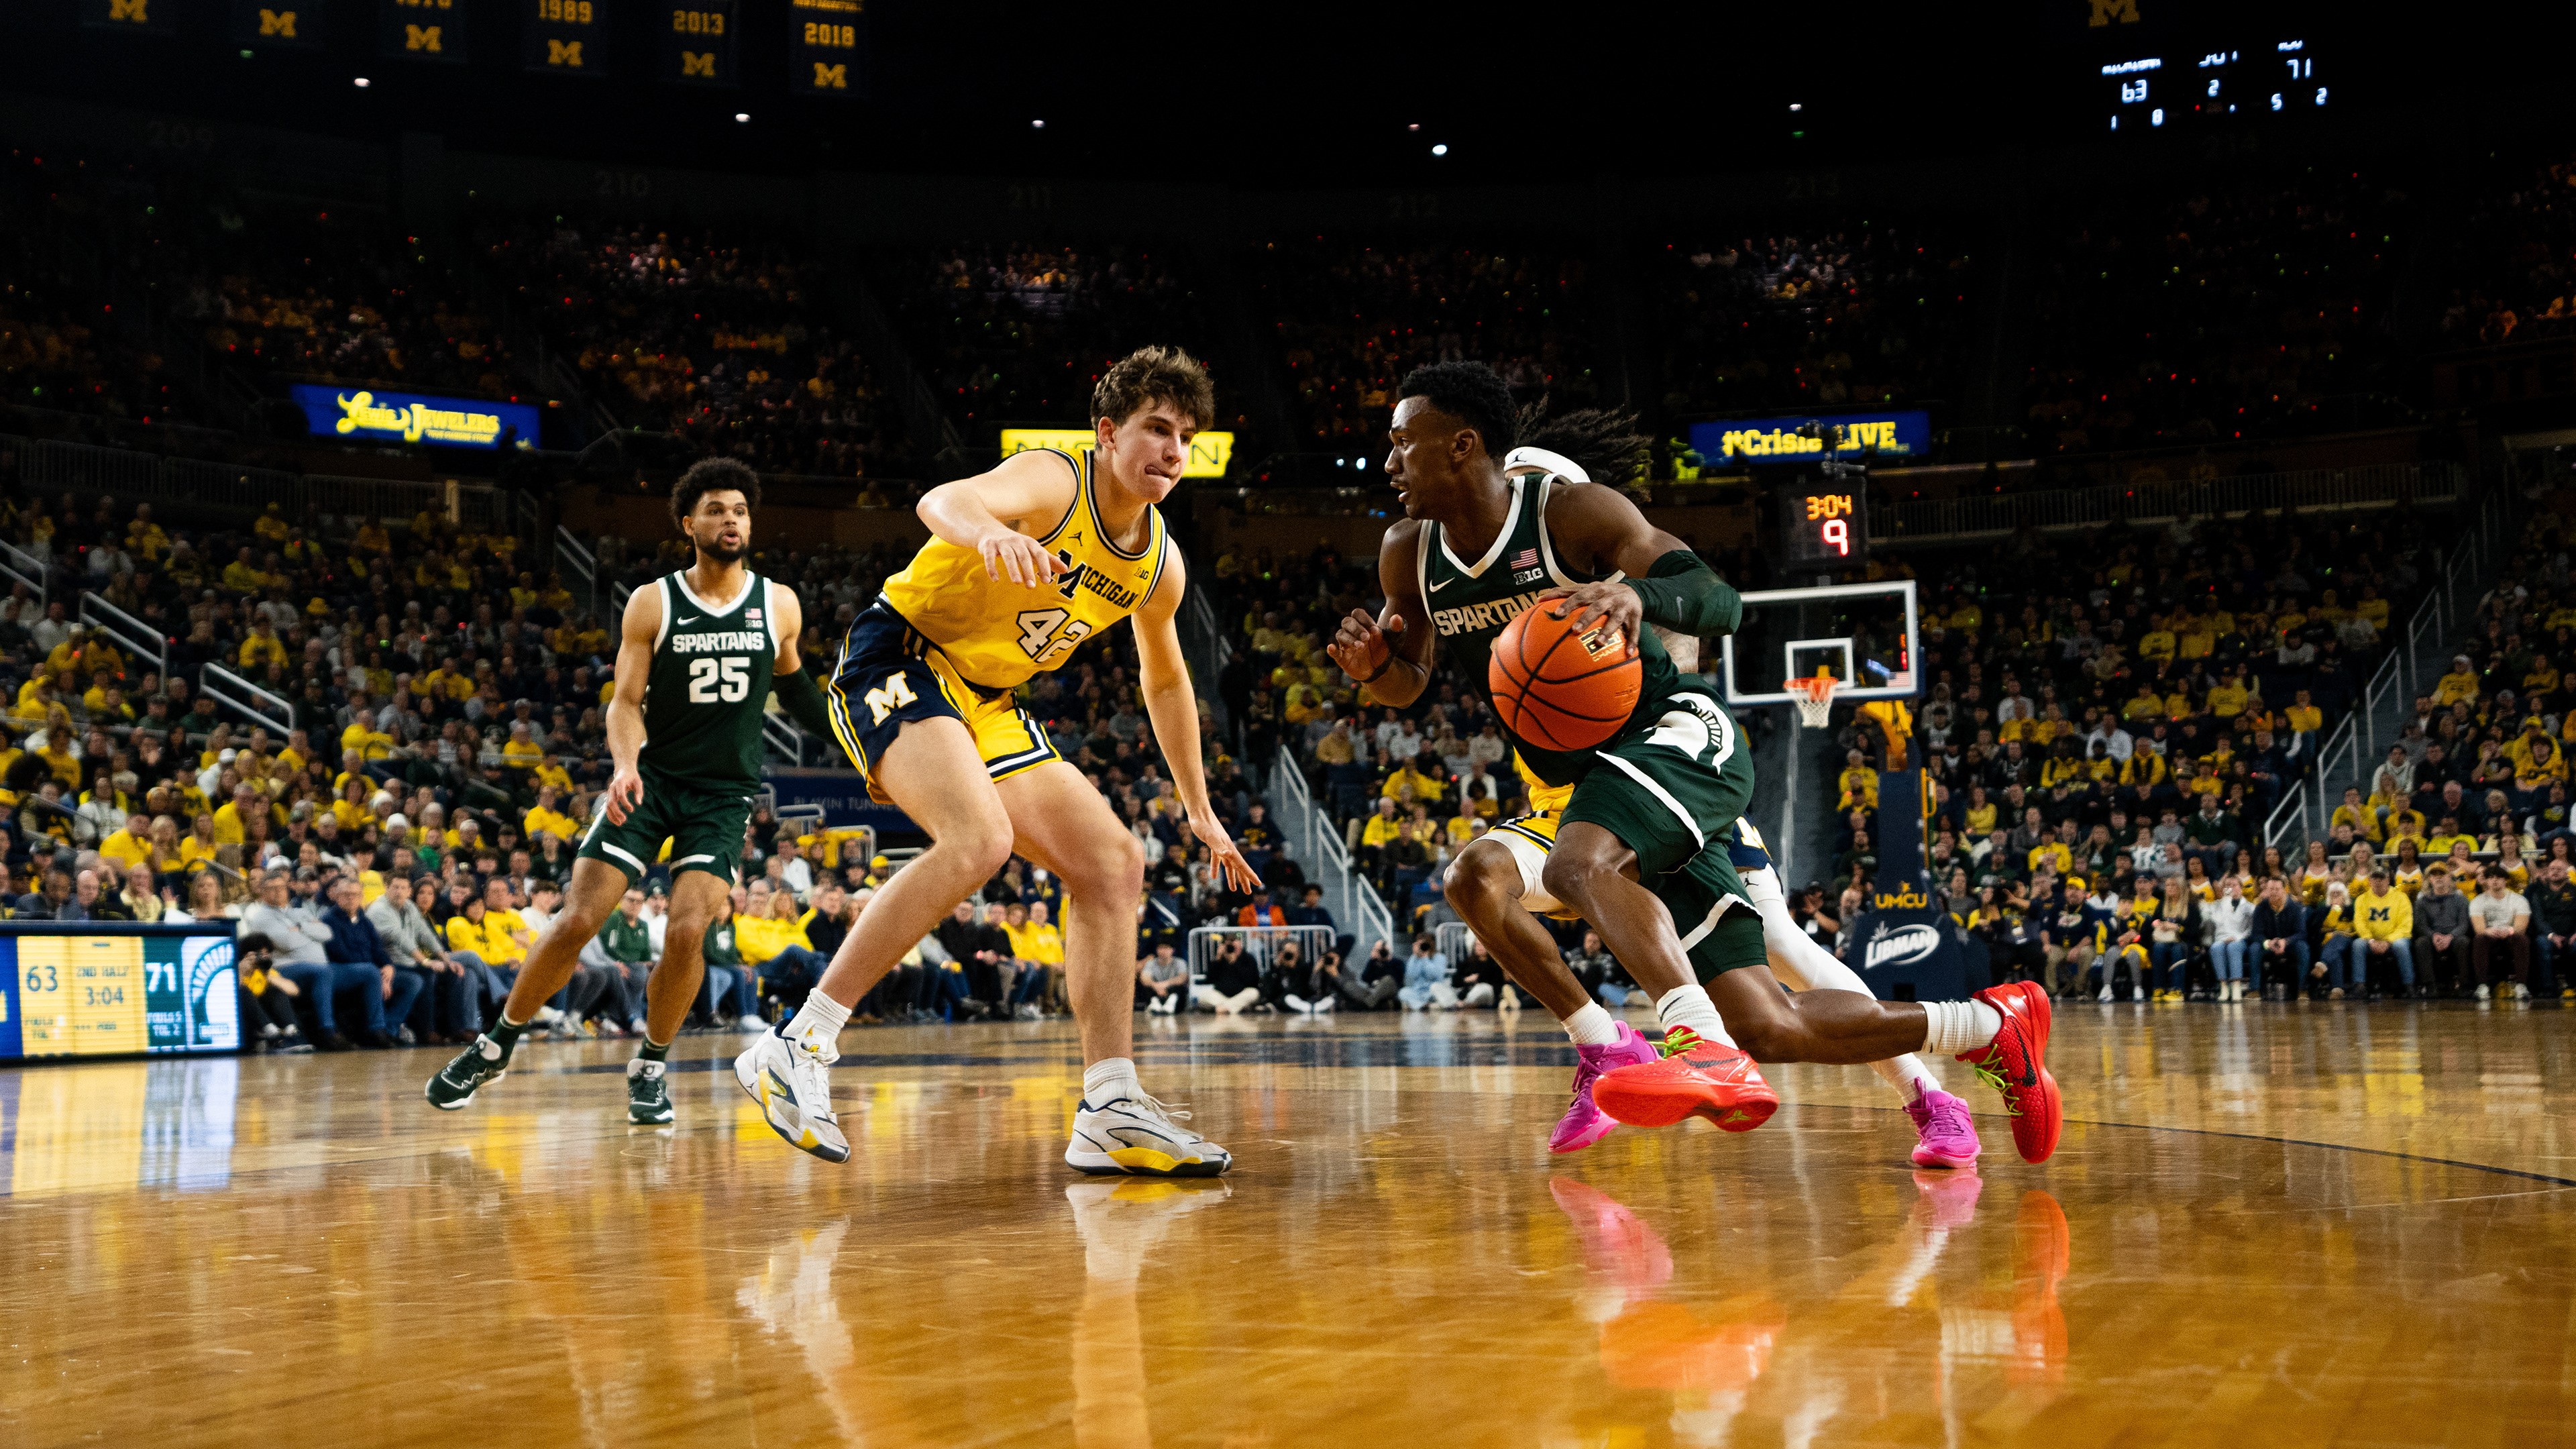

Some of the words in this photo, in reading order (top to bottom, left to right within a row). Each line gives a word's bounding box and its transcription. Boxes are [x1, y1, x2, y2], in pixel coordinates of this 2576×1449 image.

[260, 9, 297, 38] M
[539, 0, 592, 23] 1989
[674, 10, 724, 35] 2013
[406, 24, 441, 52] M
[804, 22, 855, 48] 2018
[547, 39, 583, 66] M
[682, 51, 716, 76] M
[814, 62, 847, 88] M
[2286, 58, 2312, 80] 71
[2207, 78, 2220, 97] 2
[2271, 93, 2283, 111] 5
[2316, 87, 2328, 106] 2
[1806, 495, 1852, 520] 3:04
[1822, 519, 1849, 557] 9
[1037, 548, 1138, 610] MICHIGAN
[1433, 588, 1551, 637] SPARTAN
[672, 632, 765, 653] SPARTANS
[1016, 607, 1092, 663] 42
[689, 657, 750, 703] 25
[864, 670, 918, 727] M
[1875, 893, 1927, 909] UMCU
[2369, 908, 2390, 922] M
[1865, 931, 1933, 969] LIBMAN
[26, 965, 58, 991] 63
[146, 962, 176, 992] 71
[85, 986, 124, 1006] 3:04
